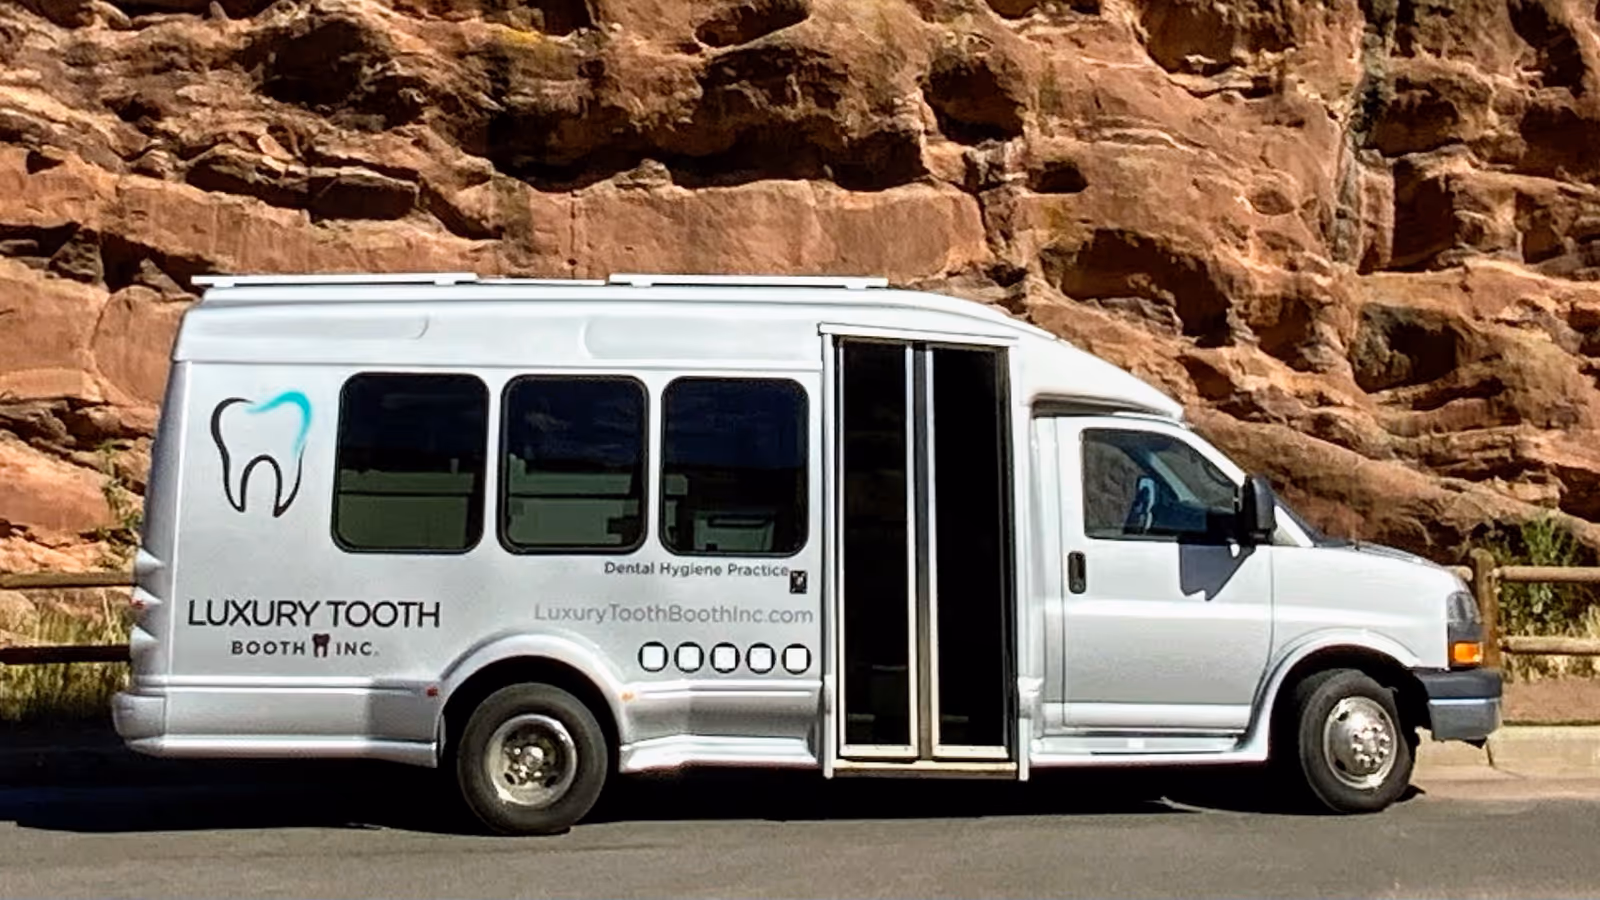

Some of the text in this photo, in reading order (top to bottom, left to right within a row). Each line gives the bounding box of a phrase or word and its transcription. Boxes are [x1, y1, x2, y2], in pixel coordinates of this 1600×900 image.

[604, 561, 789, 577] Dental Hygiene Practice
[188, 600, 440, 628] LUXURY TOOTH
[534, 603, 814, 624] LuxuryToothBoothInc.com
[231, 640, 306, 655] BOOTH
